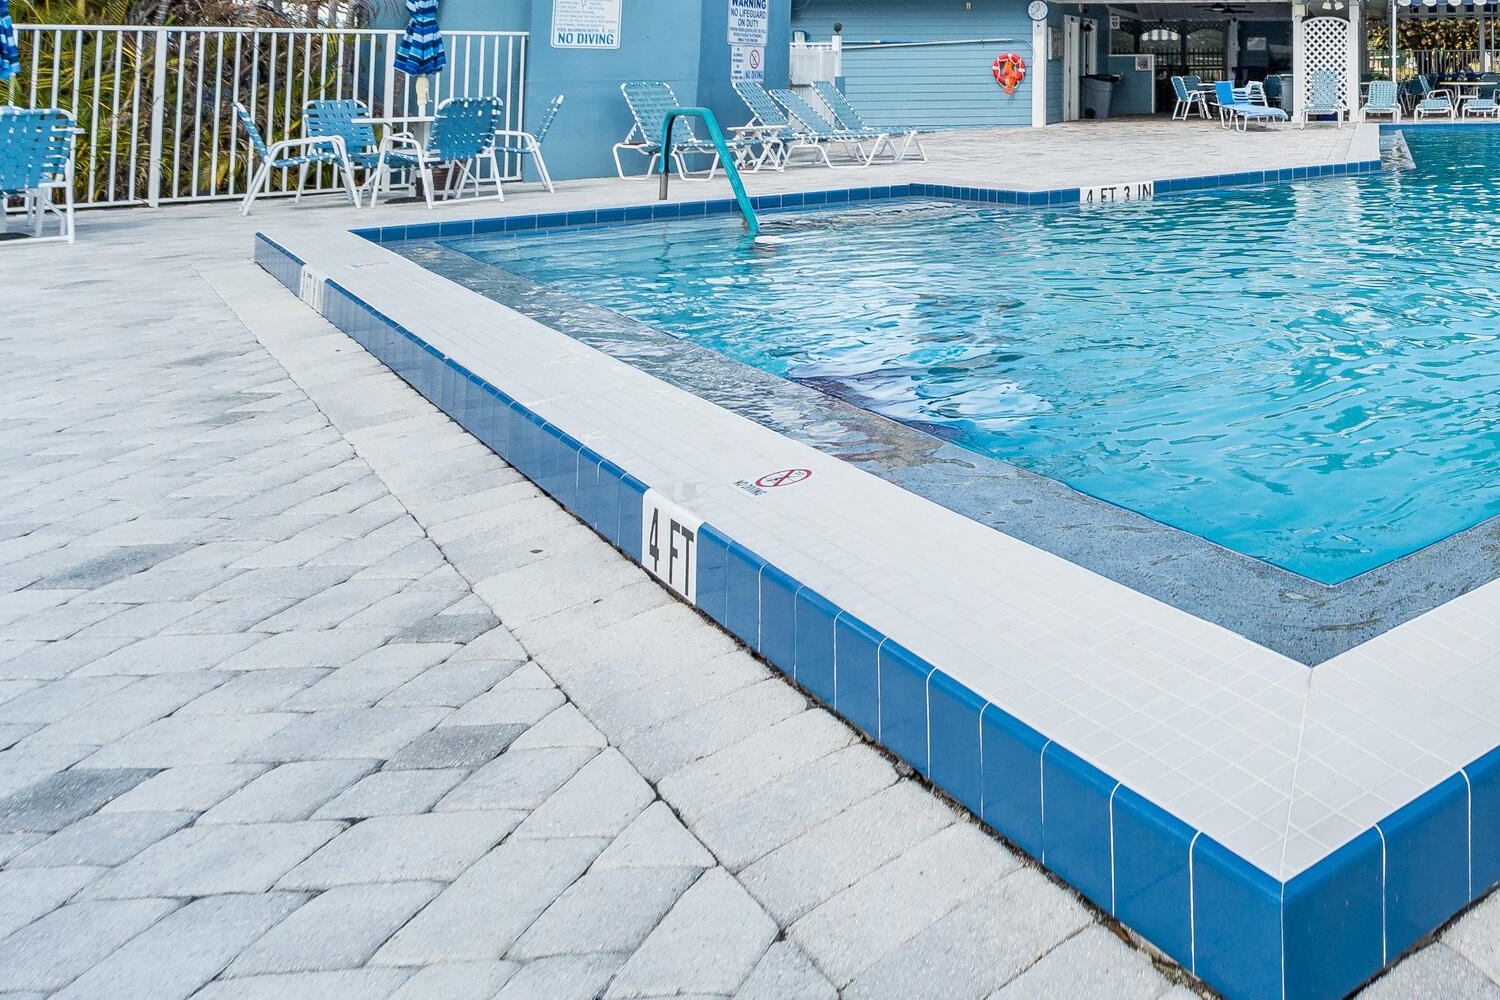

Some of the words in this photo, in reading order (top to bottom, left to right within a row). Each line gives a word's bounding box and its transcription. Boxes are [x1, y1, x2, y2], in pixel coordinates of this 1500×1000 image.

[731, 8, 738, 16] NO
[740, 9, 766, 19] LIFEGUARD
[738, 18, 745, 27] ON
[746, 18, 759, 28] DUTY
[558, 32, 574, 44] NO
[577, 33, 614, 45] DIVING
[1086, 189, 1093, 203] 4
[1100, 187, 1117, 202] FT
[1124, 186, 1130, 201] 3
[1138, 184, 1152, 200] IN
[649, 507, 659, 573] 4
[669, 518, 694, 597] FT
